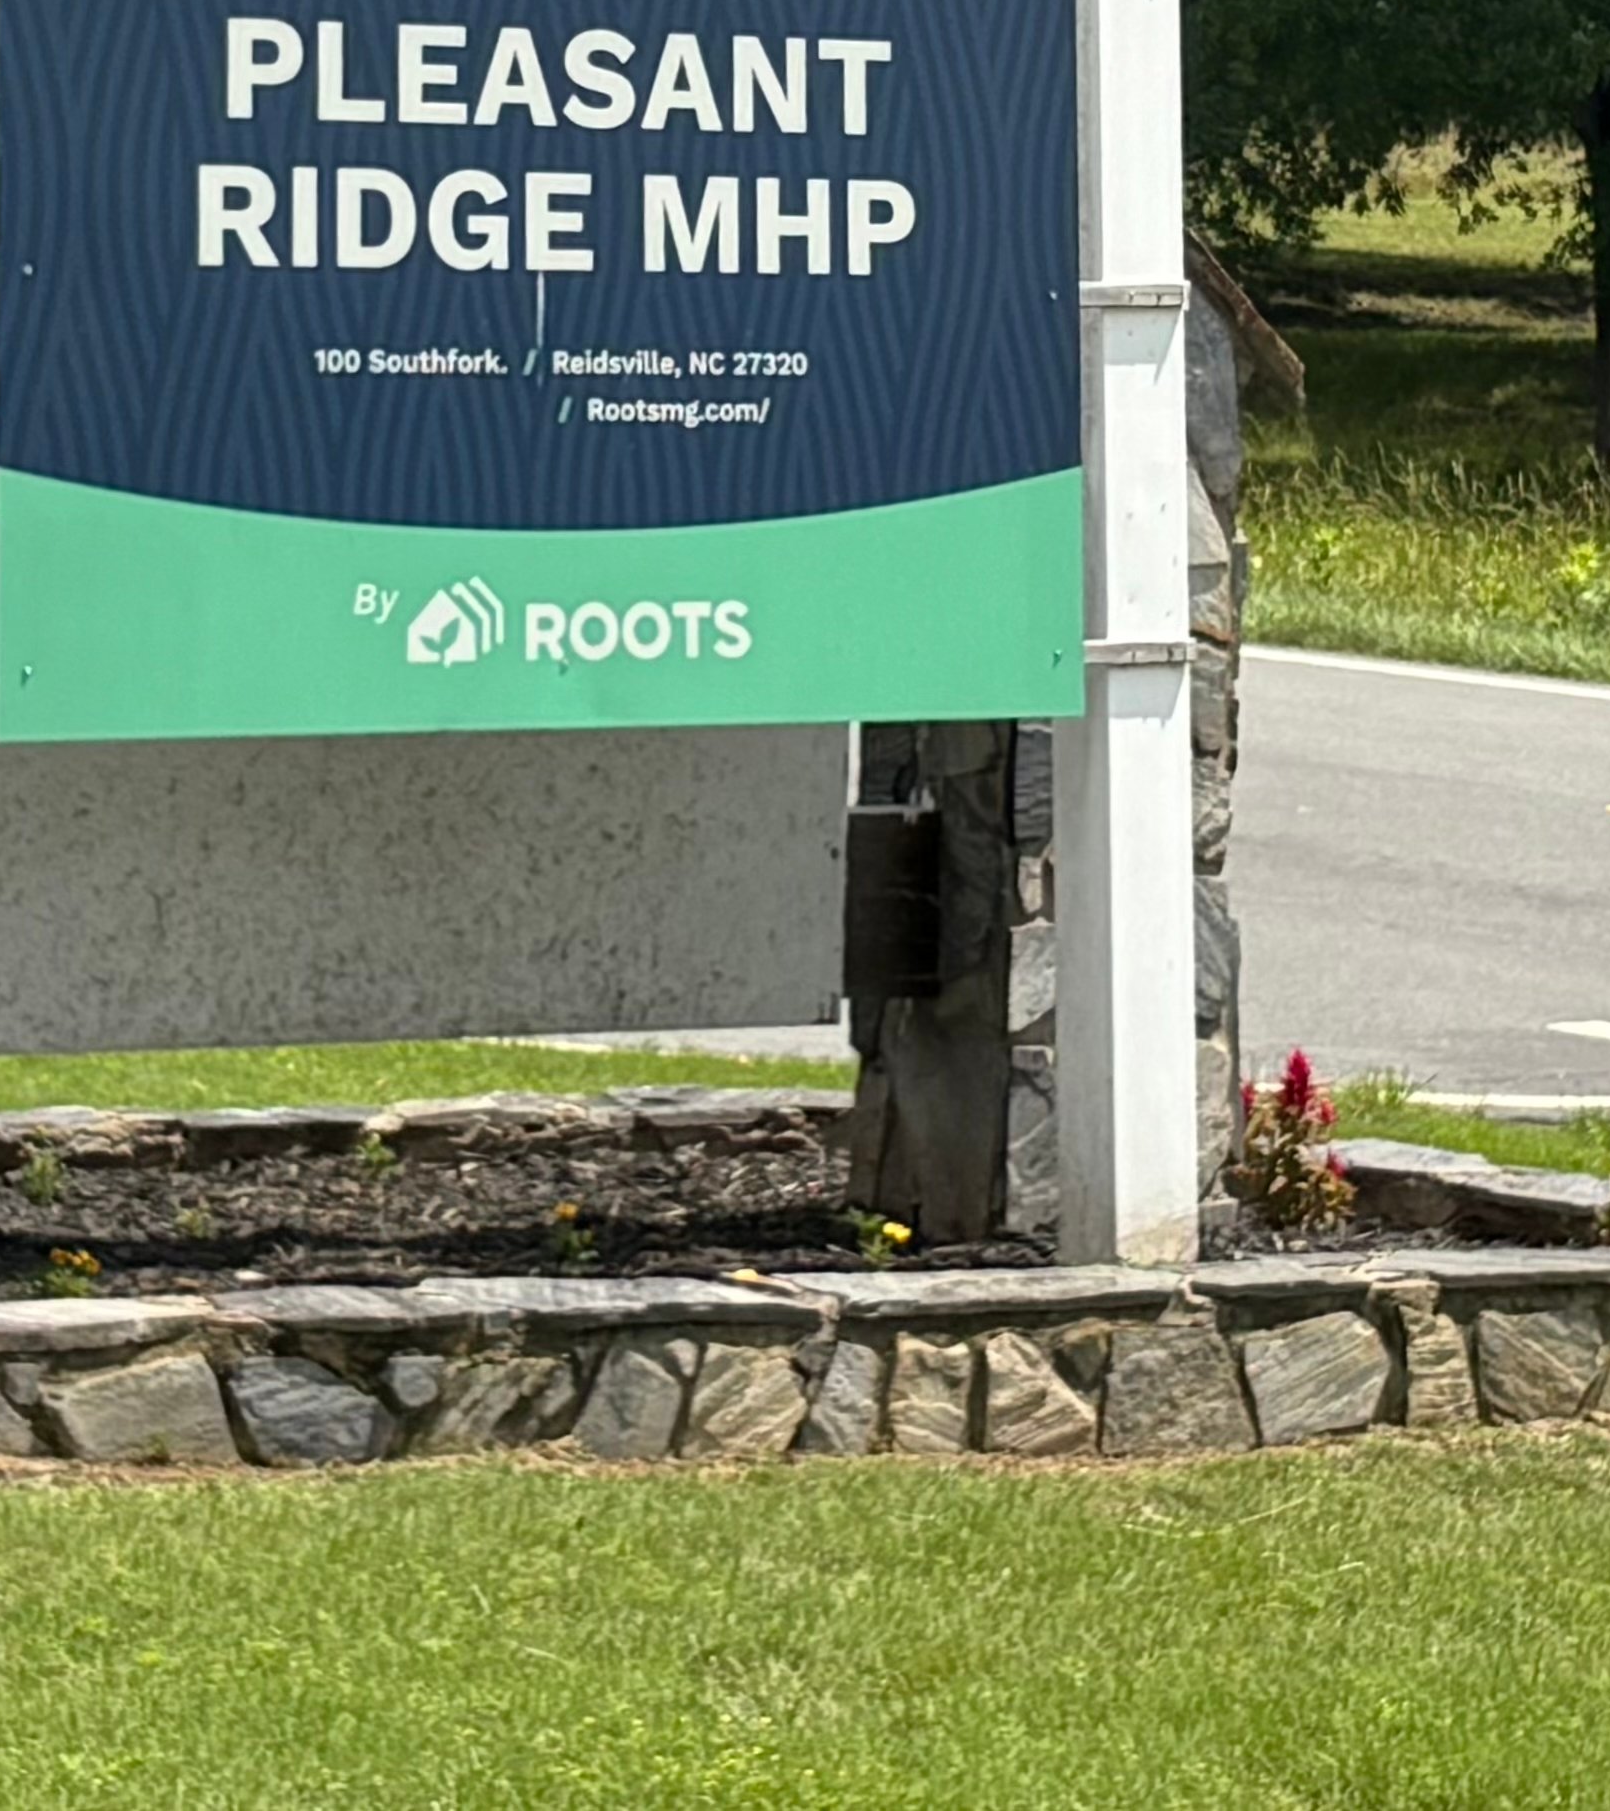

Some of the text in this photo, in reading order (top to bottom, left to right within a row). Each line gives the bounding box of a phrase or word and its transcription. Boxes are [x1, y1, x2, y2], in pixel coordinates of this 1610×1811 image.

[225, 16, 892, 136] PLEASANT
[197, 163, 916, 277] RIDGE MHP
[314, 349, 361, 373] 100
[369, 349, 508, 375] Southfork.
[552, 351, 682, 378] Reidsville,
[689, 353, 726, 375] NC
[733, 353, 808, 376] 27320
[587, 397, 770, 428] Rootsmg.com/
[353, 583, 399, 624] By
[525, 600, 753, 663] ROOTS
